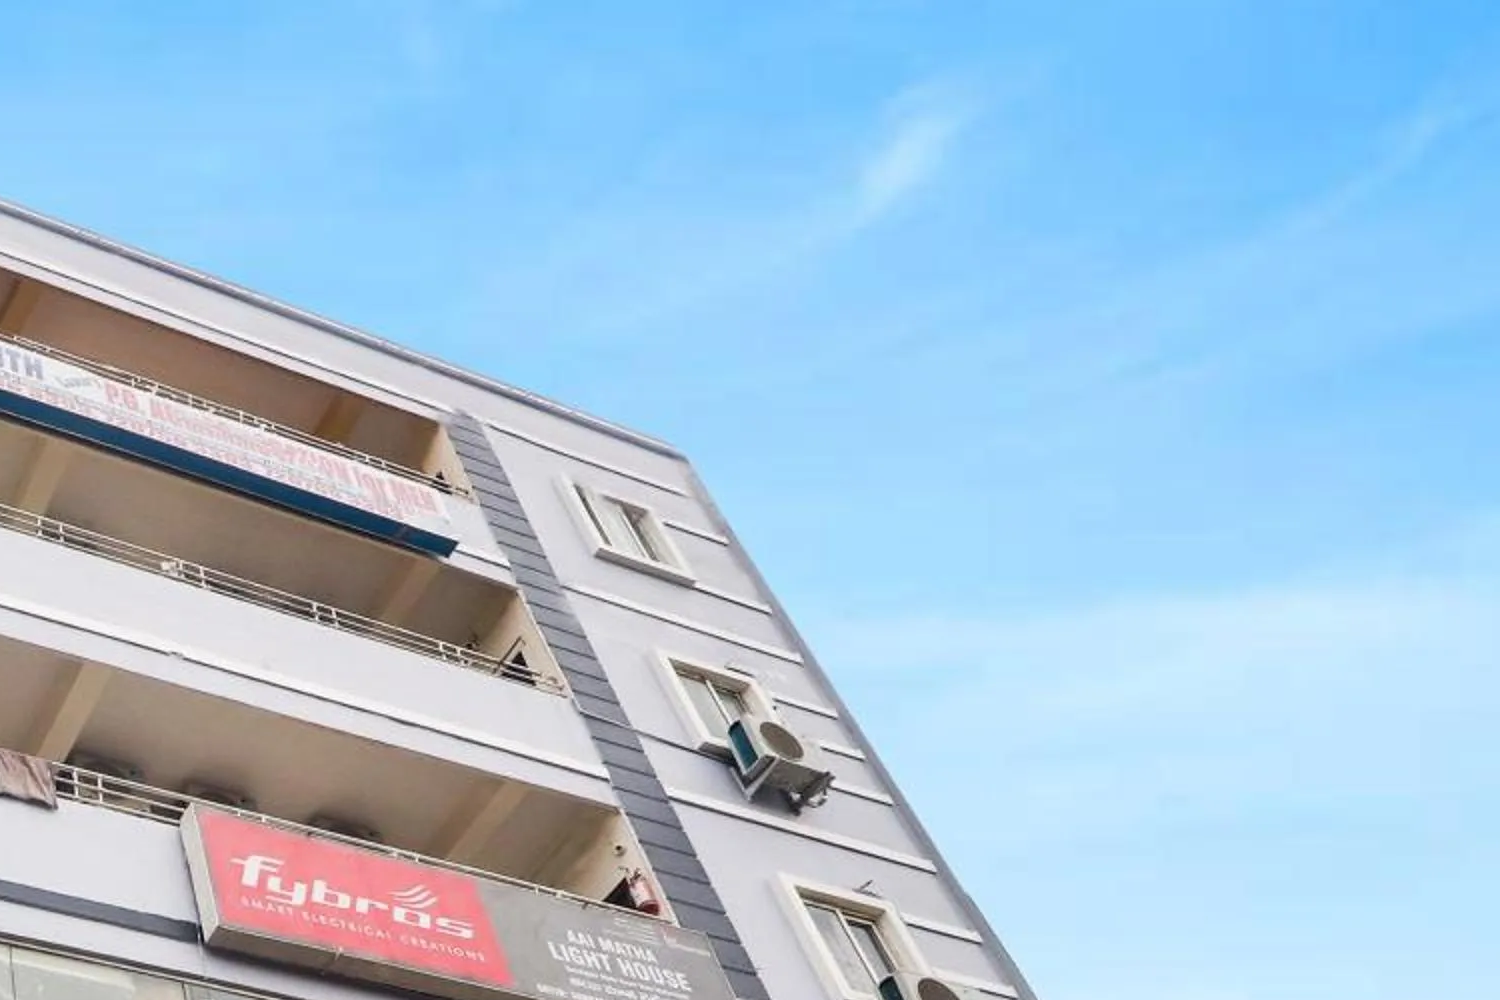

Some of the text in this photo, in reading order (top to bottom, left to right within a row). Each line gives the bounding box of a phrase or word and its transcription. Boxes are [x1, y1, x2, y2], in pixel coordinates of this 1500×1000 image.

[230, 855, 474, 939] fybros
[240, 896, 293, 916] SMART
[302, 911, 391, 940] ELECTRICAL
[547, 941, 613, 973] LIGHT
[616, 957, 693, 993] HOUSE
[566, 929, 596, 950] AAI
[599, 936, 658, 964] MATHA
